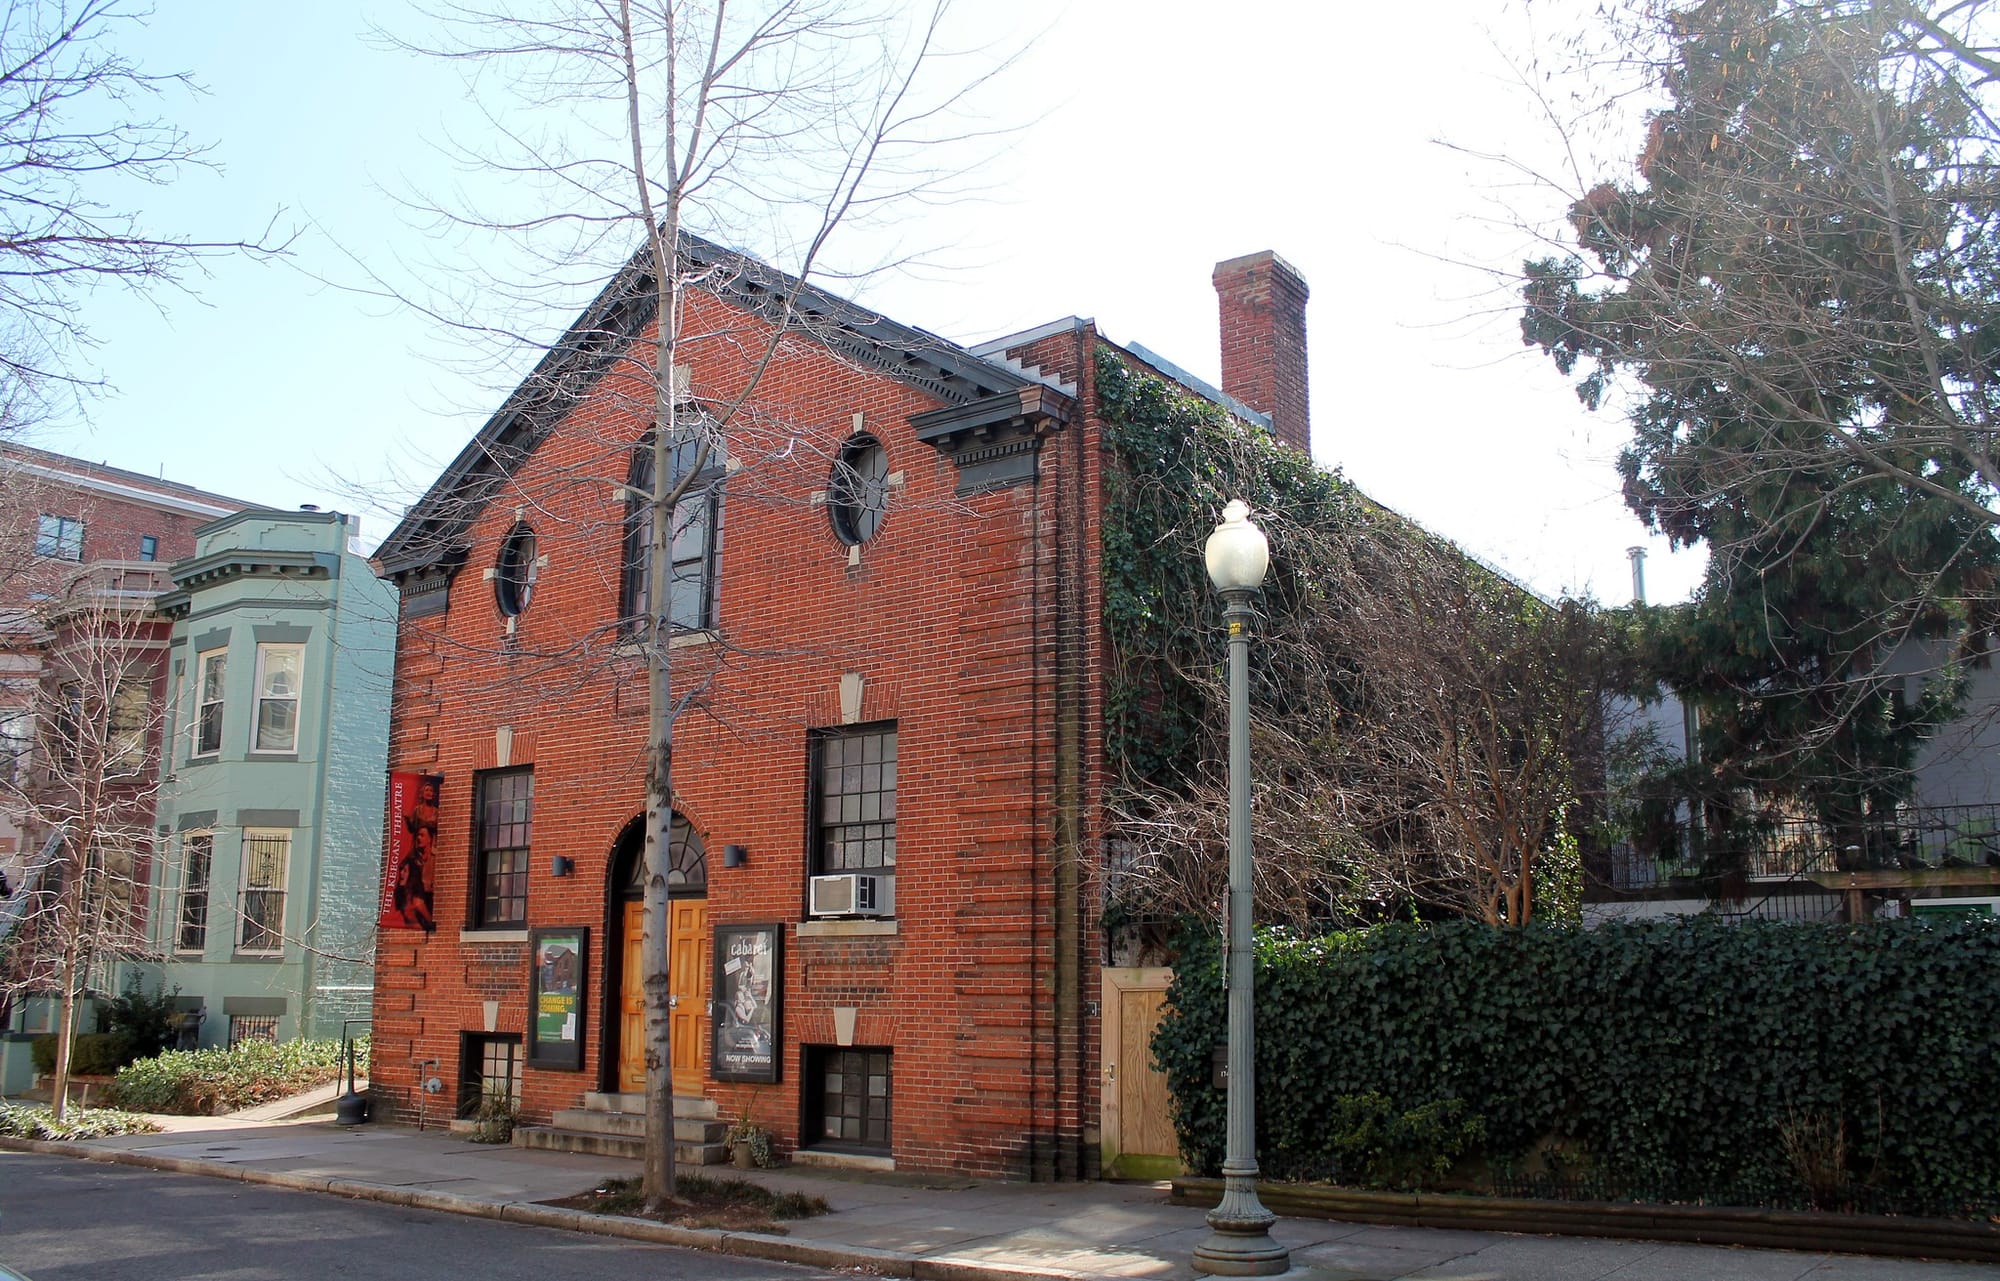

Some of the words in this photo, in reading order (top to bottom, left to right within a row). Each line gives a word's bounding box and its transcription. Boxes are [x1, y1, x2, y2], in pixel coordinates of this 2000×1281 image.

[394, 782, 403, 835] THEATRE
[388, 839, 401, 887] KEEGAN
[383, 890, 394, 914] THE
[731, 938, 768, 956] cabaret
[538, 996, 565, 1004] CHANGE
[566, 996, 573, 1005] IS
[726, 1054, 741, 1063] NOW
[742, 1054, 771, 1064] SHOWING
